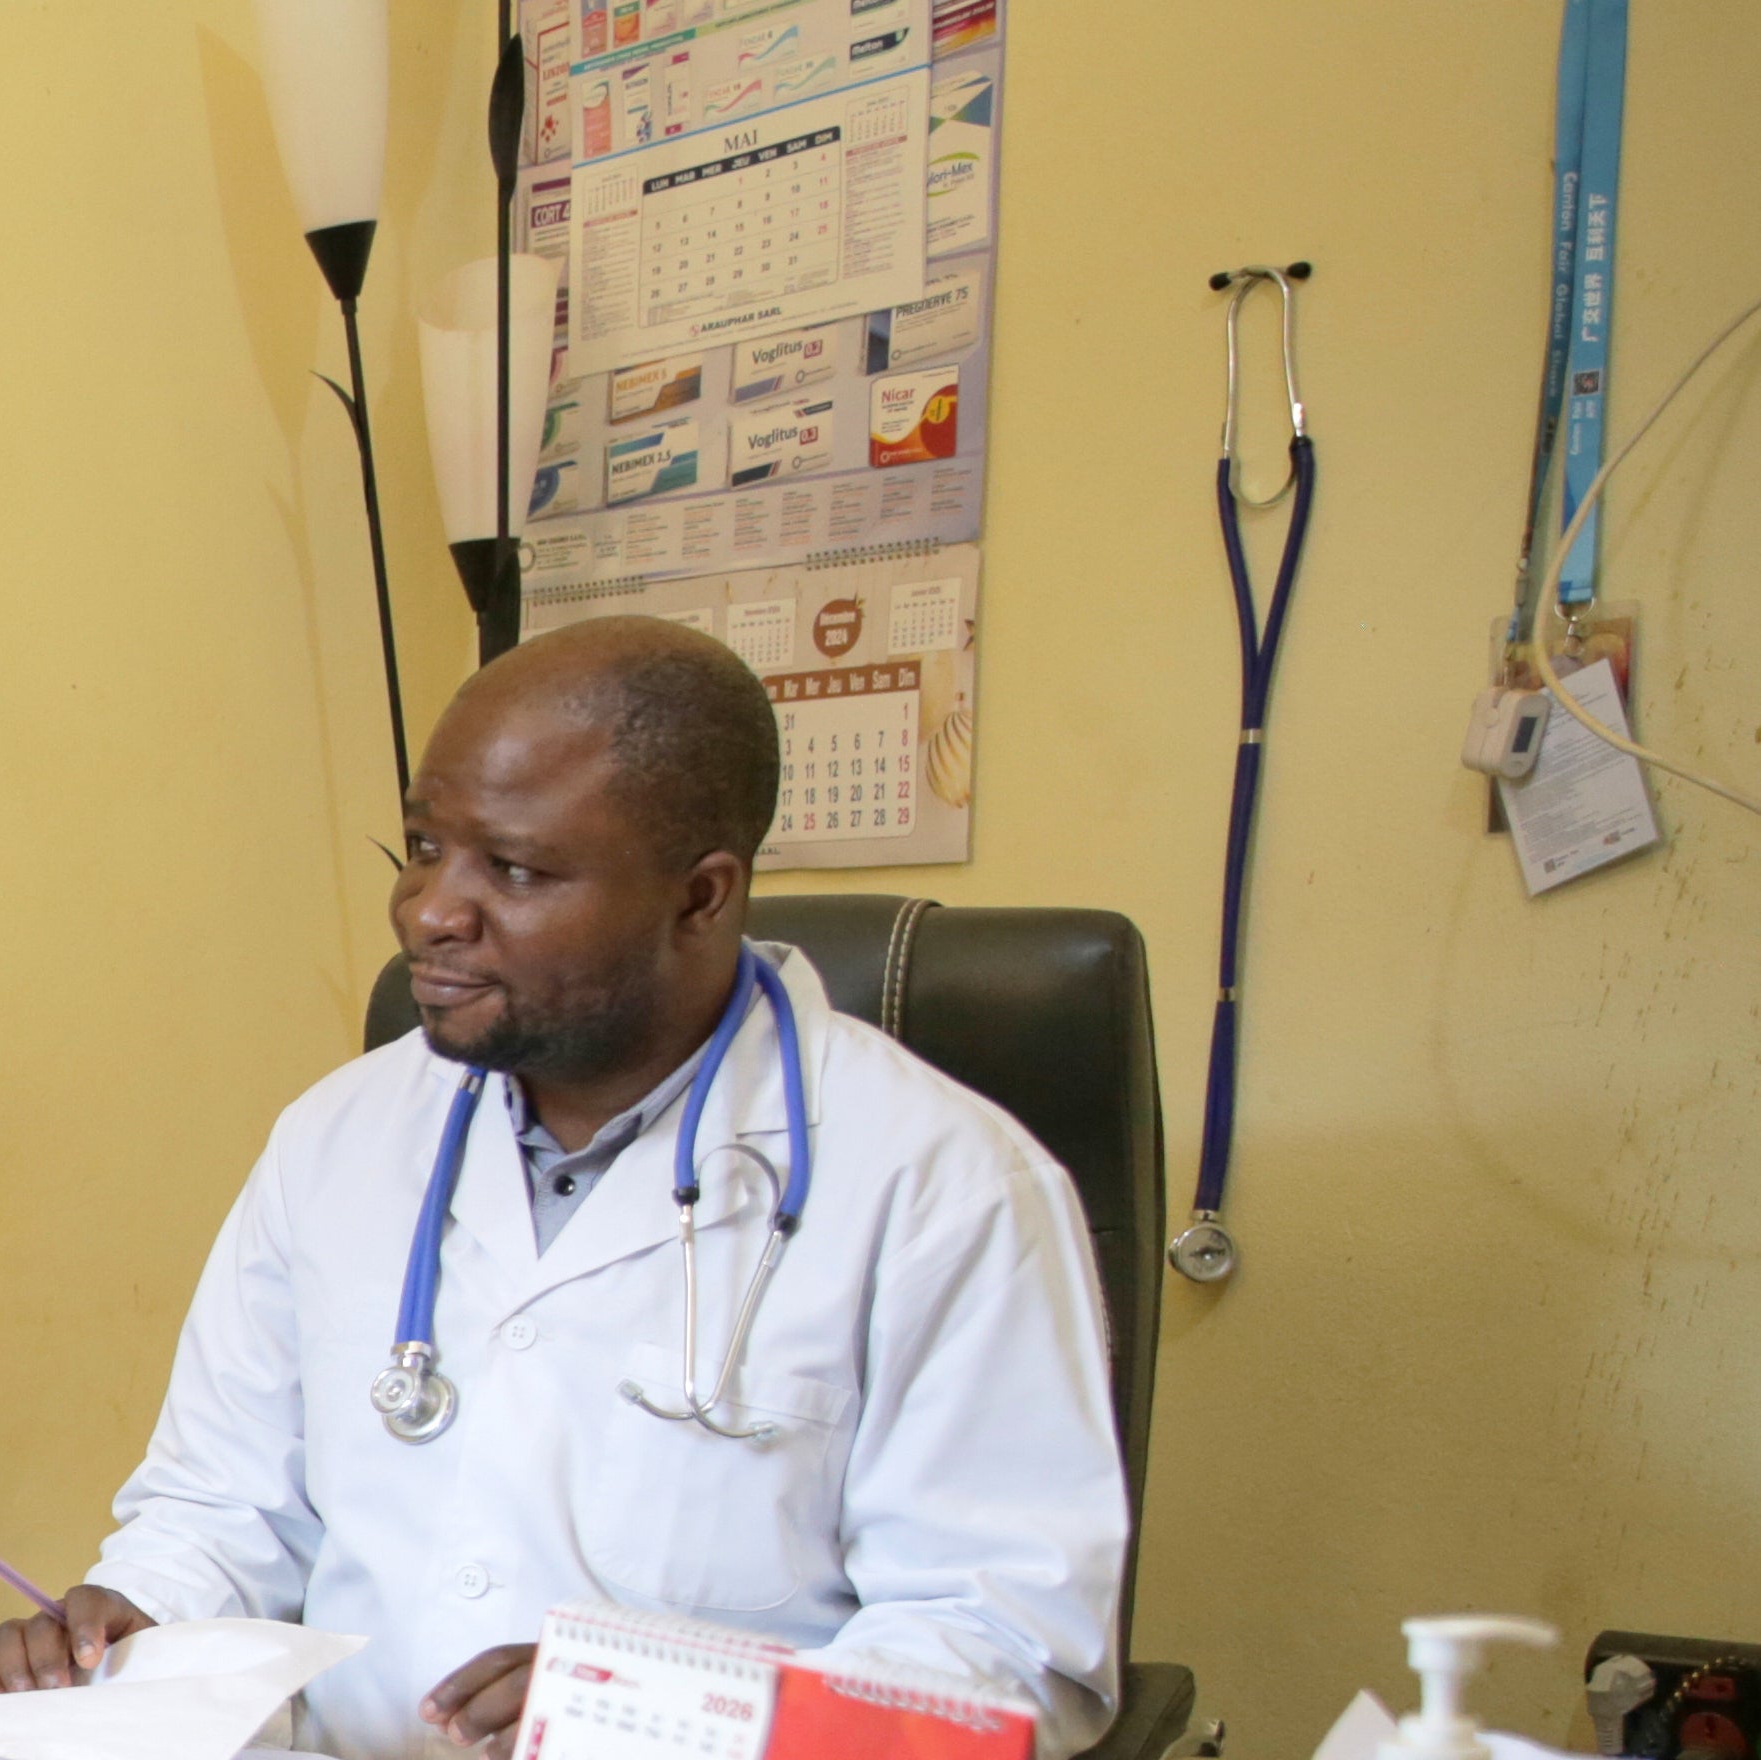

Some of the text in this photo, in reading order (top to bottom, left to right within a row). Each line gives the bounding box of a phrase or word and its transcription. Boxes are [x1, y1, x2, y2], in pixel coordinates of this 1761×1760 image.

[723, 129, 759, 153] MAI
[651, 132, 834, 191] LUN MAR MER JEU VEN SAM DIM
[792, 184, 800, 193] 10
[819, 177, 828, 185] 11
[1561, 171, 1577, 232] Canton
[534, 205, 560, 228] CORT
[653, 201, 828, 253] 12 13 14 15 16 17 18
[653, 225, 828, 275] 19 20 21 22 23 24 25
[1558, 242, 1575, 273] Fair
[651, 256, 797, 298] 26 27 28 29 30 31
[1582, 193, 1607, 342] 广交世界 互利天下
[956, 287, 968, 300] 75
[757, 307, 782, 319] SARL
[753, 341, 803, 364] Voglitus
[882, 389, 915, 403] Nicar
[748, 427, 817, 449] Voglitus 0.3
[612, 454, 655, 474] NEBIMEX
[825, 630, 848, 646] 2024
[805, 677, 821, 696] Mer
[828, 676, 842, 694] Jeu
[849, 673, 865, 691] Ven
[872, 671, 891, 689] Sam
[898, 668, 915, 687] Dim
[785, 703, 908, 730] 31 1
[786, 729, 908, 755] 3 4 5 6 7 8
[783, 755, 910, 780] 10 11 12 13 14 15
[782, 781, 910, 806] 17 18 19 20 21 22
[781, 808, 909, 831] 24 25 26 27 28 29
[701, 1692, 754, 1722] 2026
